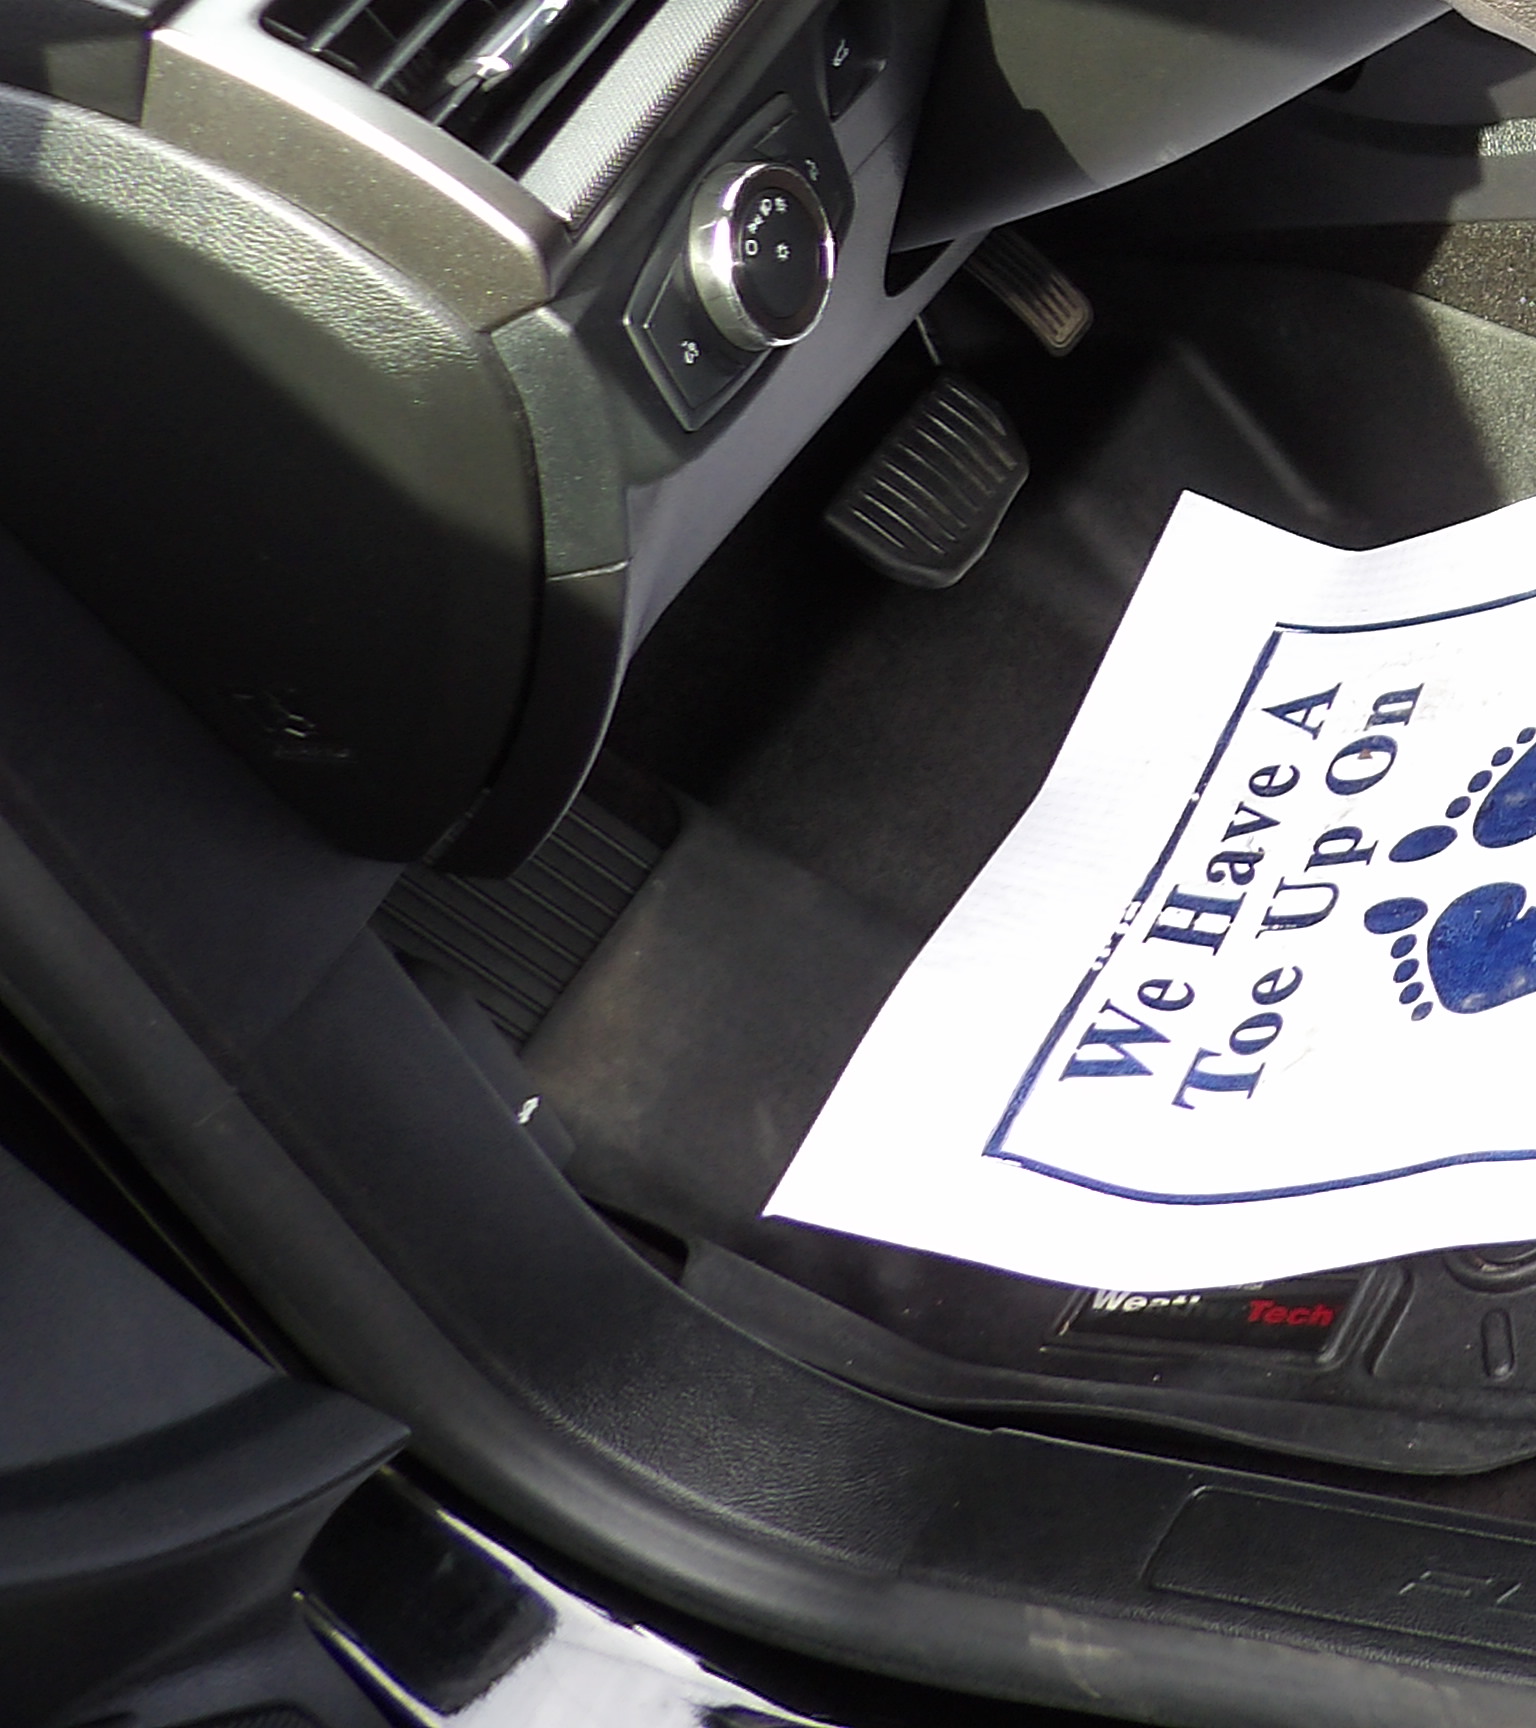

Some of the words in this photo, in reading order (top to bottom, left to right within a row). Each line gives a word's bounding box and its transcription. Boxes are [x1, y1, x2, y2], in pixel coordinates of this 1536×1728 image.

[1058, 975, 1197, 1082] We
[1149, 764, 1302, 956] Have
[1262, 682, 1341, 742] A
[1171, 964, 1304, 1112] Toe
[1256, 823, 1374, 936] Up
[1325, 681, 1424, 797] On
